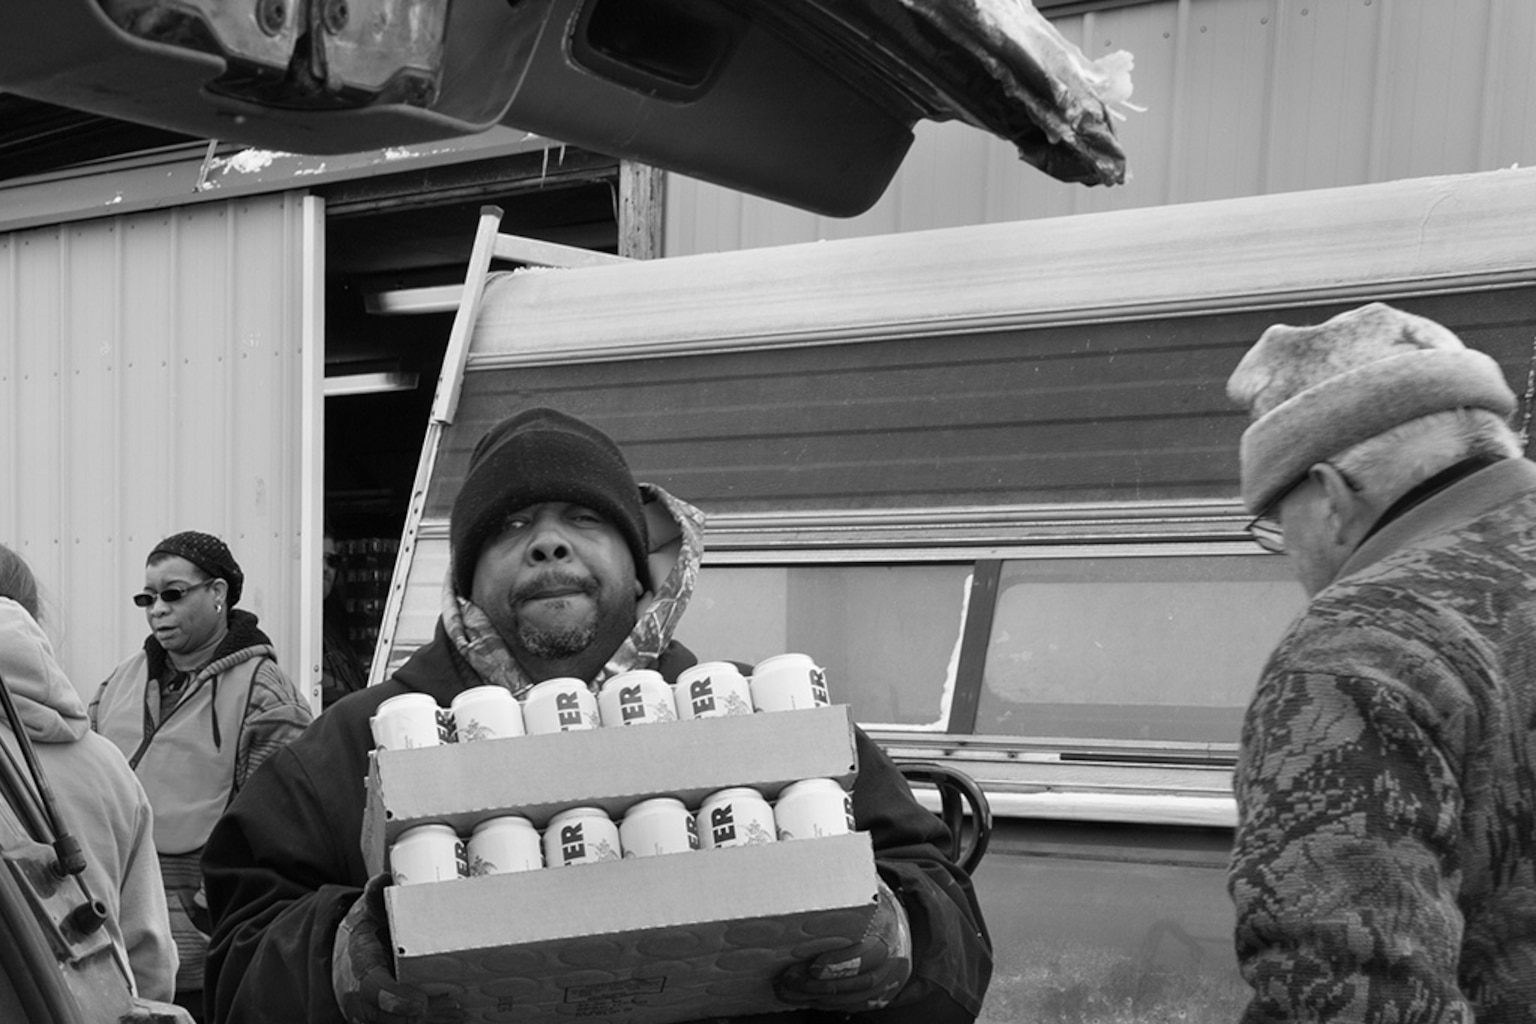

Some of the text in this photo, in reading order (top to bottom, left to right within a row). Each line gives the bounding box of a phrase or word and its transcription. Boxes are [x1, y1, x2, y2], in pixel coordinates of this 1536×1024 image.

[619, 684, 645, 726] ER
[690, 676, 716, 719] ER
[809, 668, 828, 707] ER
[556, 691, 582, 731] ER
[561, 822, 585, 866] ER
[711, 803, 736, 848] ER
[454, 841, 470, 879] ER
